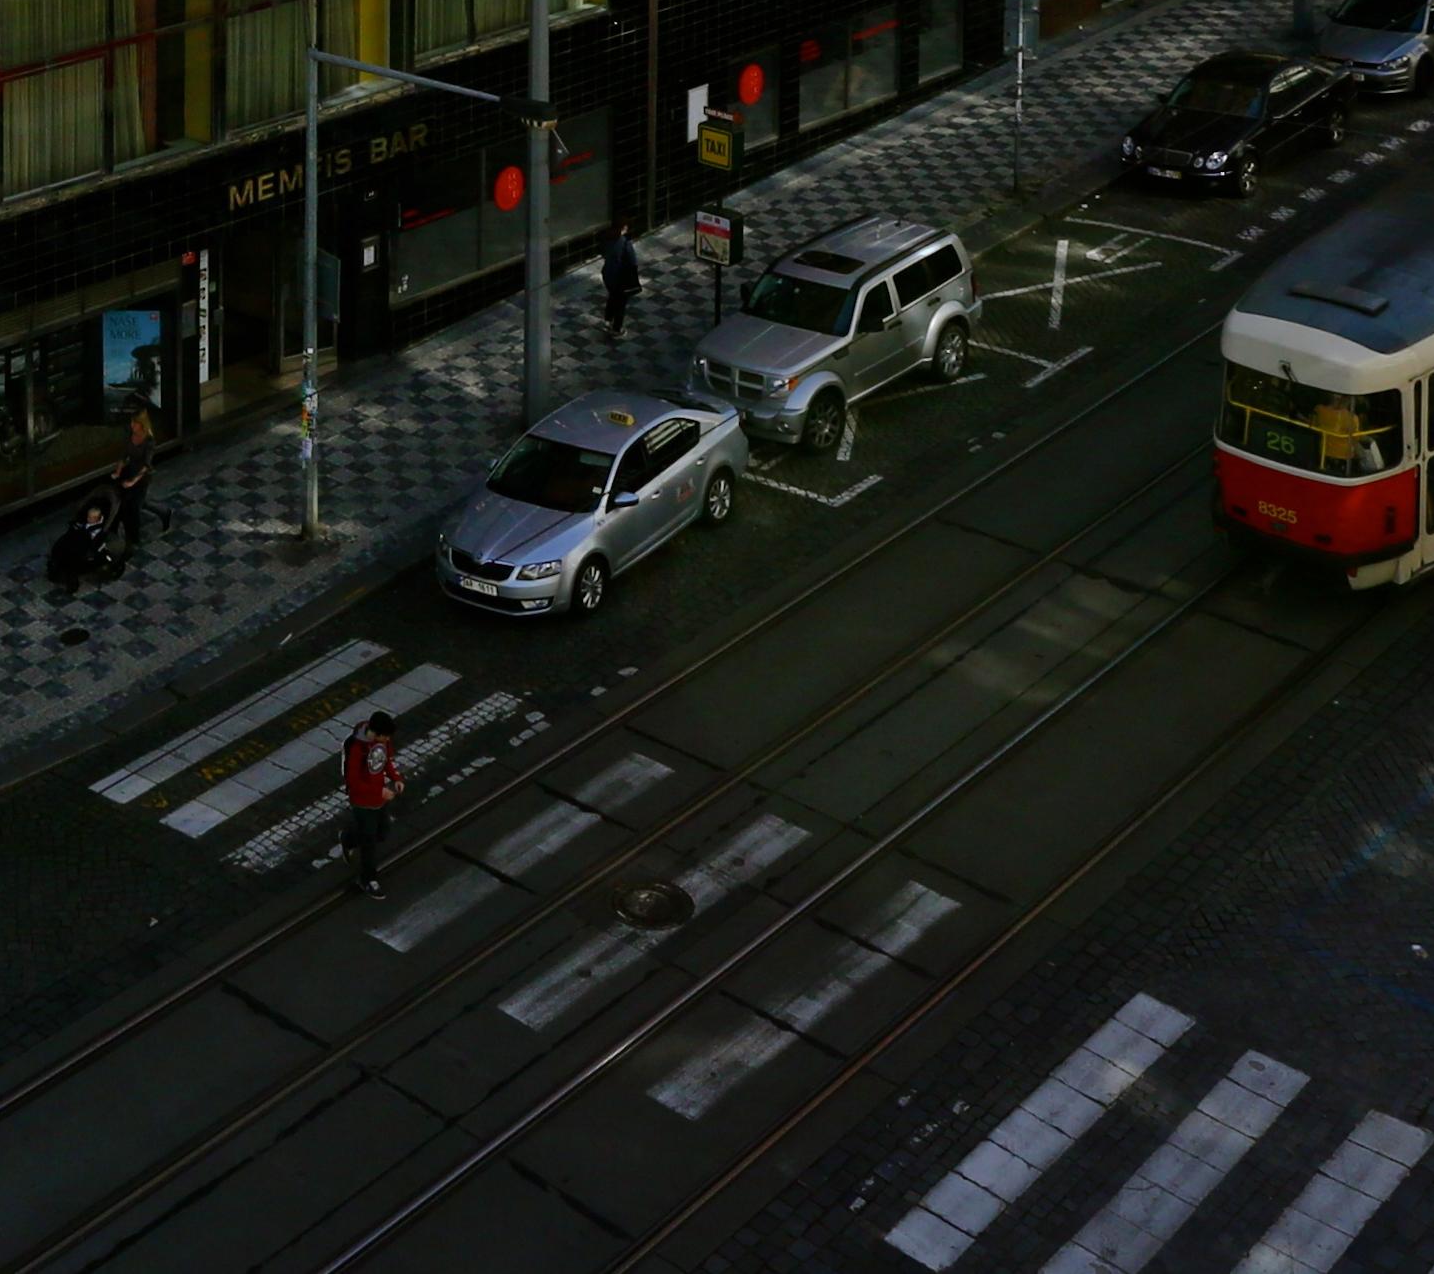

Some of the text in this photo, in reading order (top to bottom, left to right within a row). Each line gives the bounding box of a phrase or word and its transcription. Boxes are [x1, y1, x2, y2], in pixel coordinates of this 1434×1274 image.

[704, 137, 726, 157] TAXI
[227, 122, 429, 212] MEMIS BAR
[1266, 431, 1295, 455] 26
[1257, 500, 1298, 525] 8325
